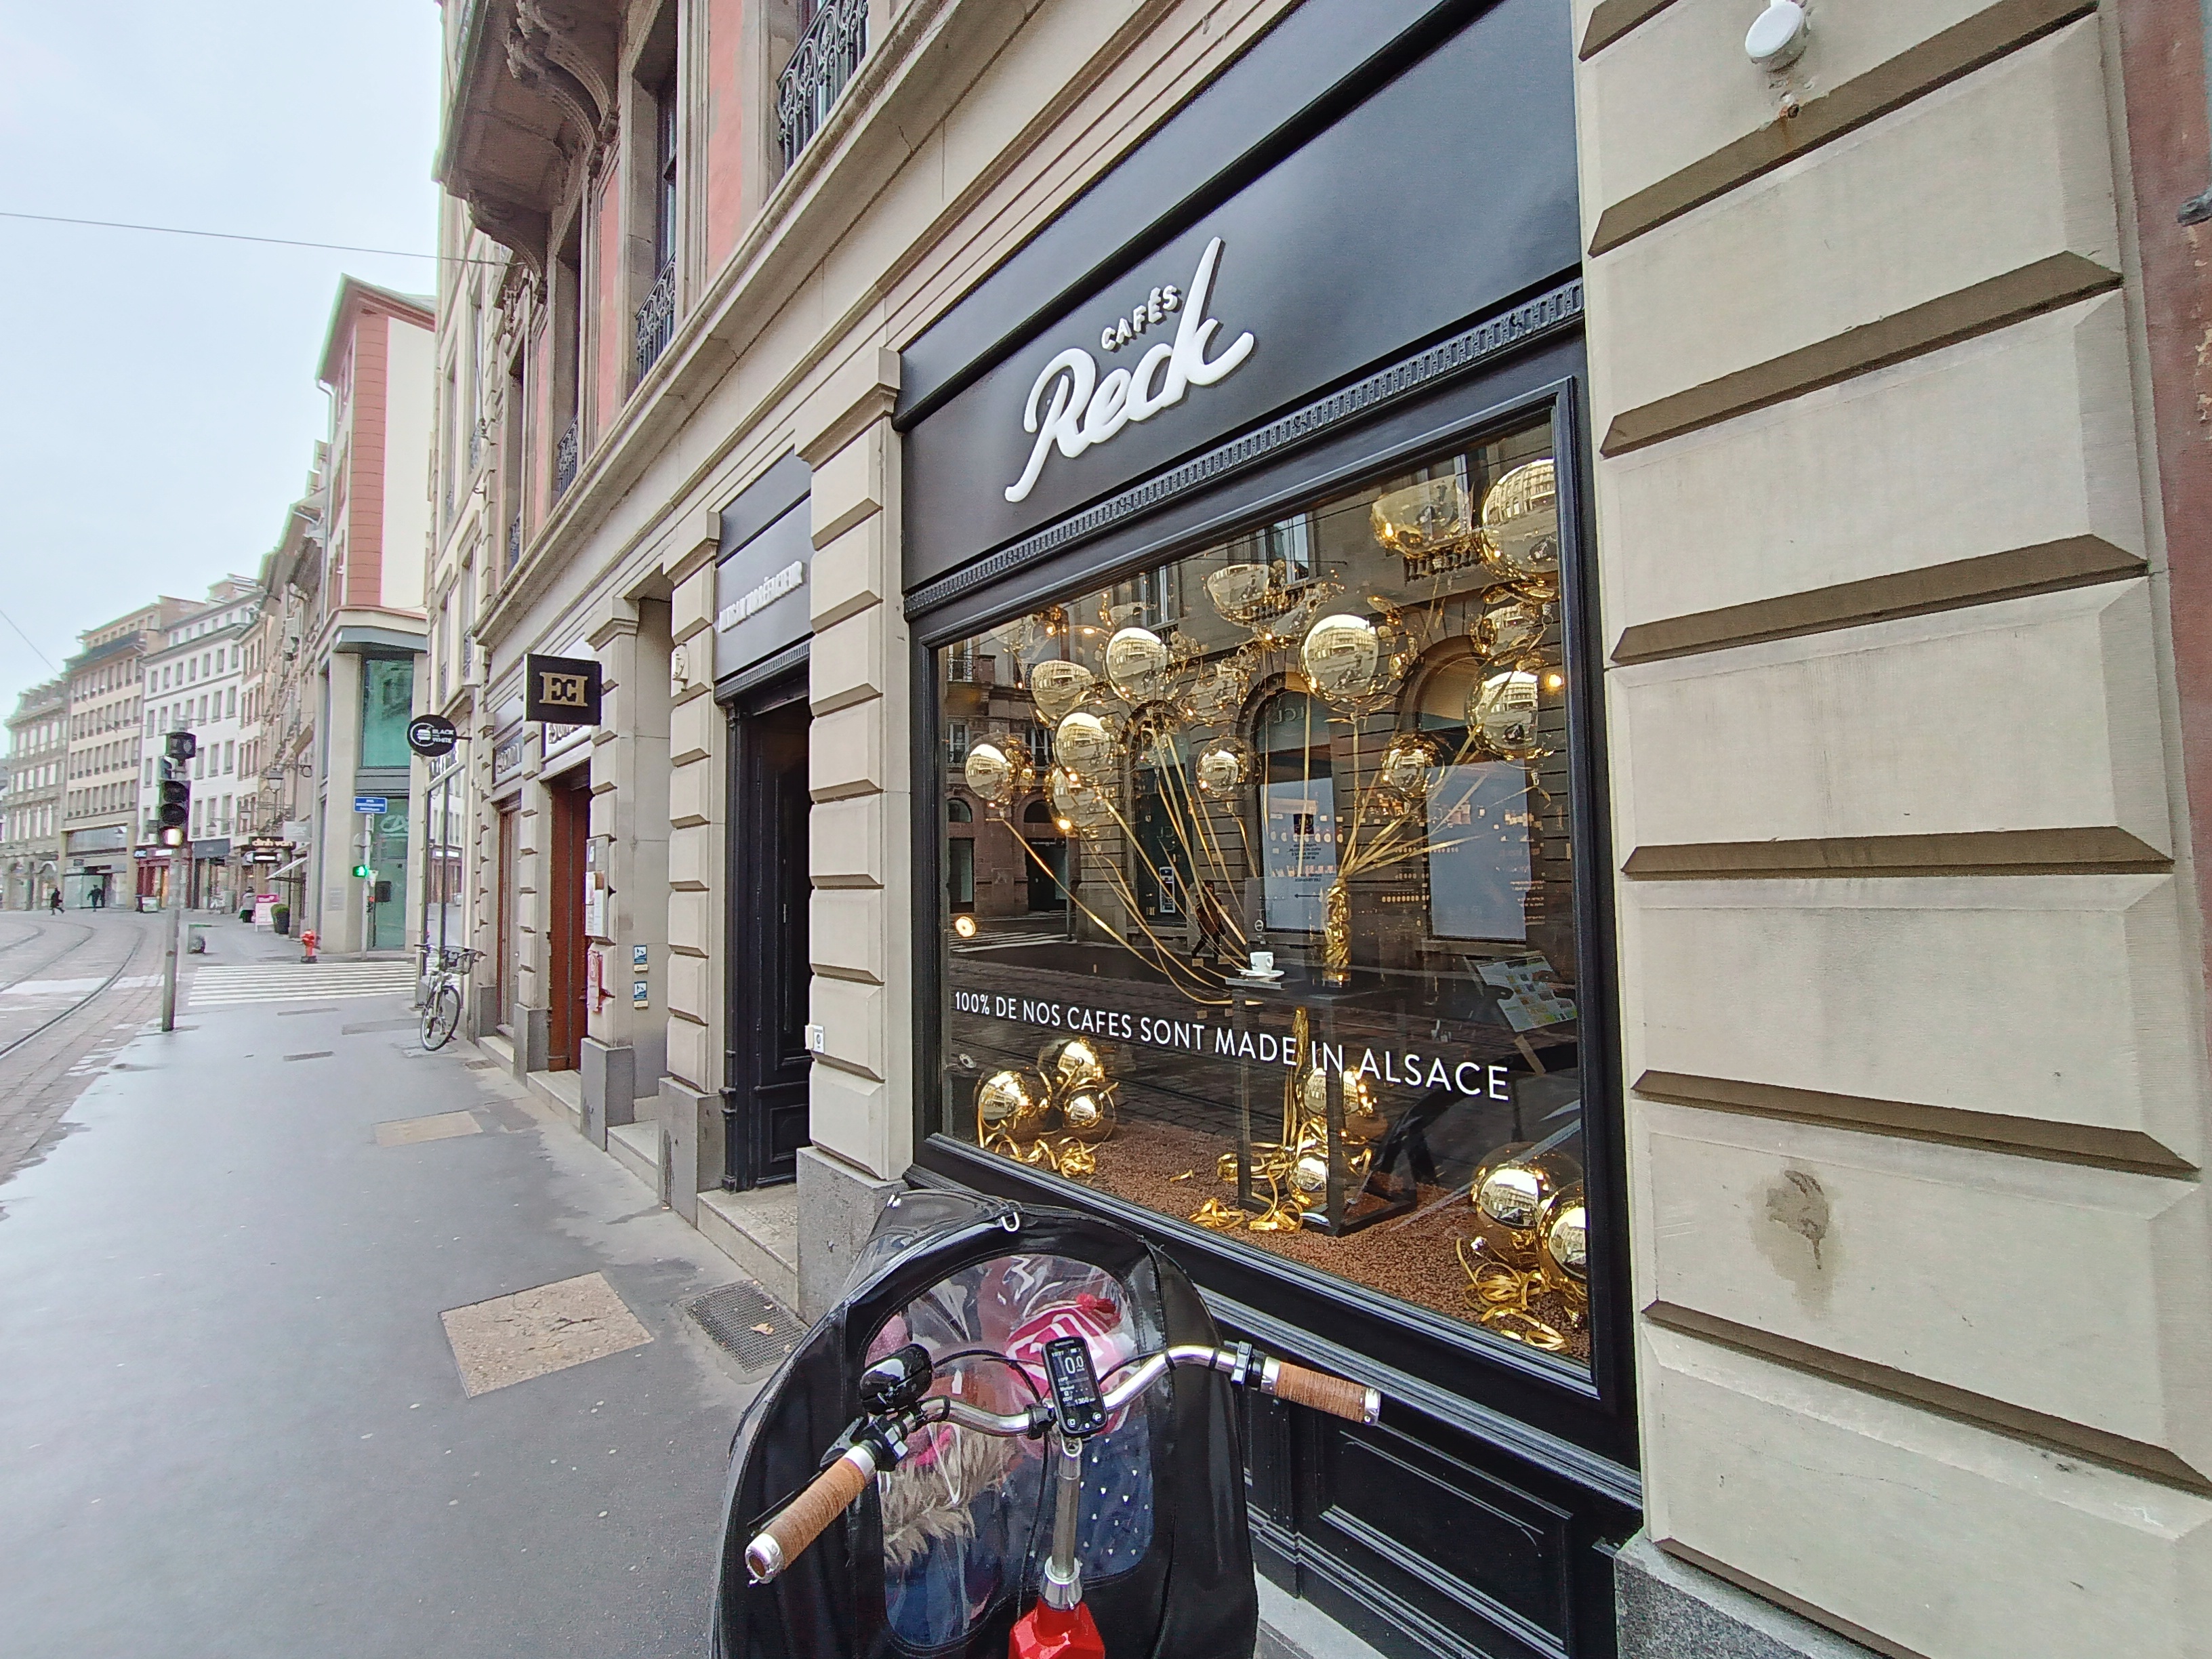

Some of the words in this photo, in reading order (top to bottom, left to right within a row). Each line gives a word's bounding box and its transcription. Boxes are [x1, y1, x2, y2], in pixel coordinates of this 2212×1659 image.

[1004, 236, 1255, 503] Reck
[251, 838, 274, 846] dinh
[955, 991, 990, 1015] 100%
[996, 996, 1017, 1019] DE
[1023, 1000, 1061, 1027] NOS
[1067, 1006, 1132, 1039] CAFES
[1140, 1017, 1205, 1050] SONT
[1214, 1027, 1298, 1065] MADE
[1311, 1040, 1343, 1078] IN
[1358, 1048, 1509, 1101] ALSACE
